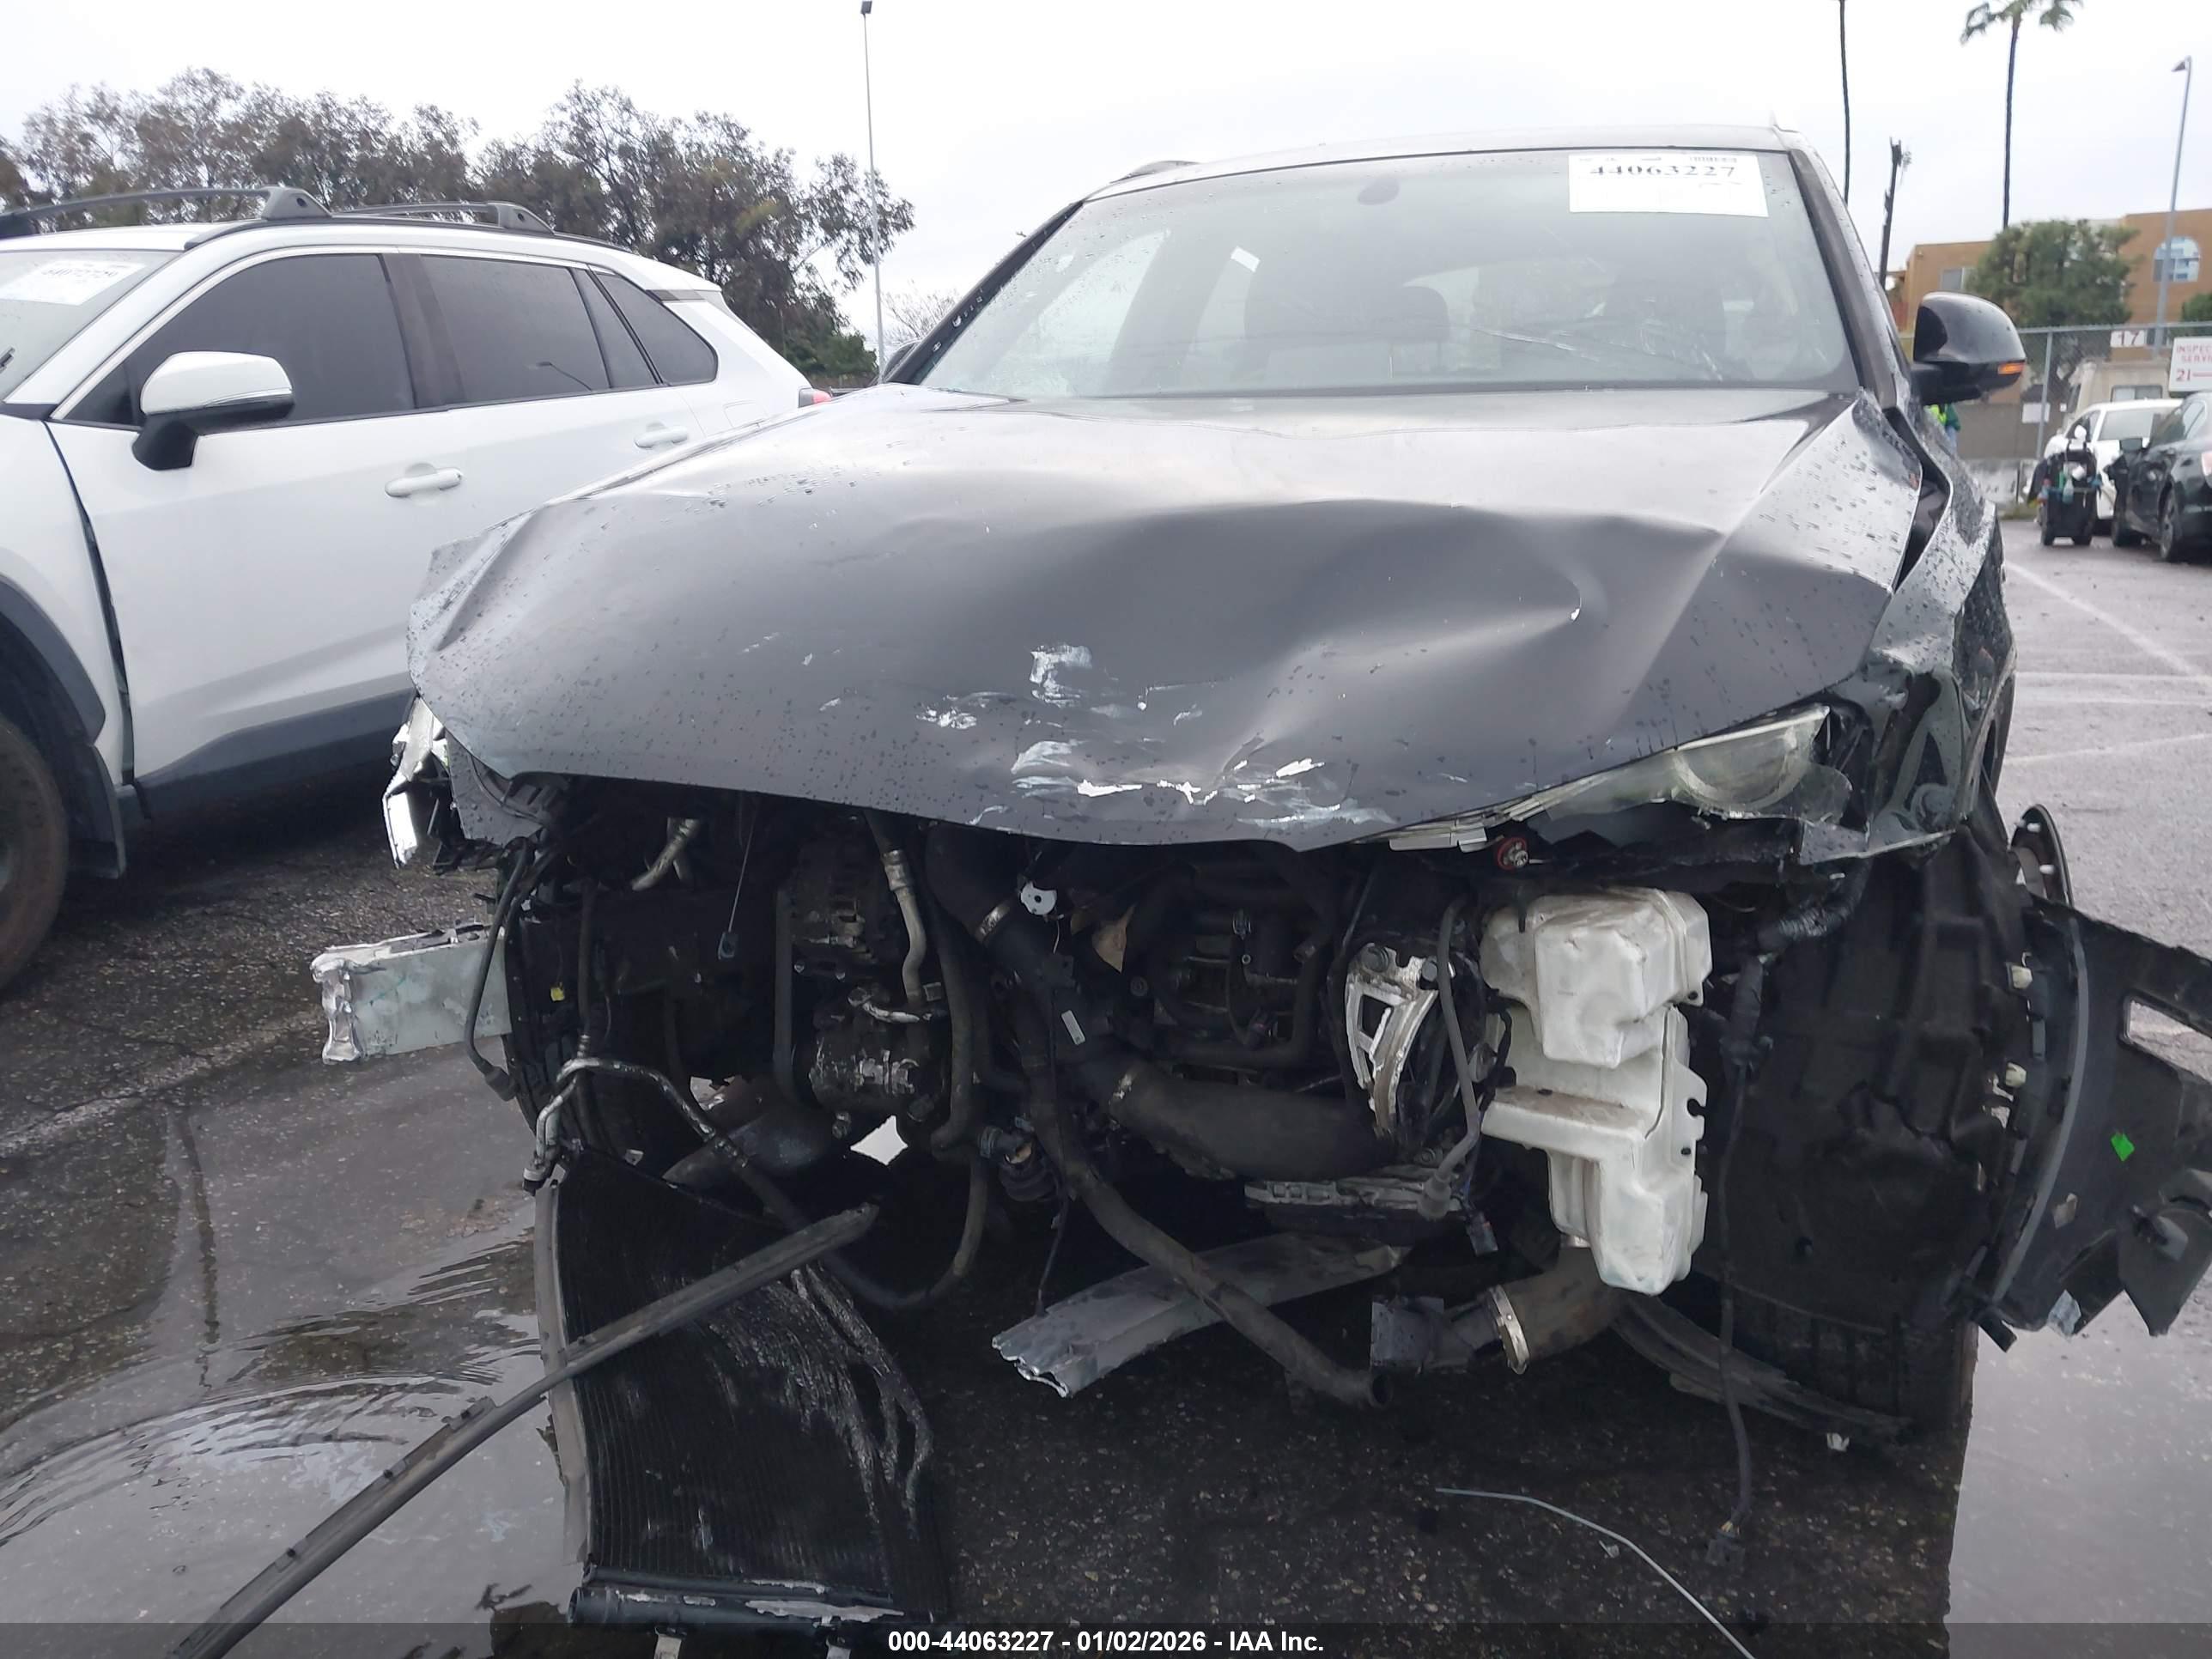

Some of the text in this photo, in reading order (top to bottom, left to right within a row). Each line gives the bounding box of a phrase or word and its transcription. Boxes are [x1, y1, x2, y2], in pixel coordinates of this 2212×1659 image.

[1589, 165, 1735, 177] 44063227
[2118, 330, 2140, 346] 17
[2176, 368, 2191, 382] 21
